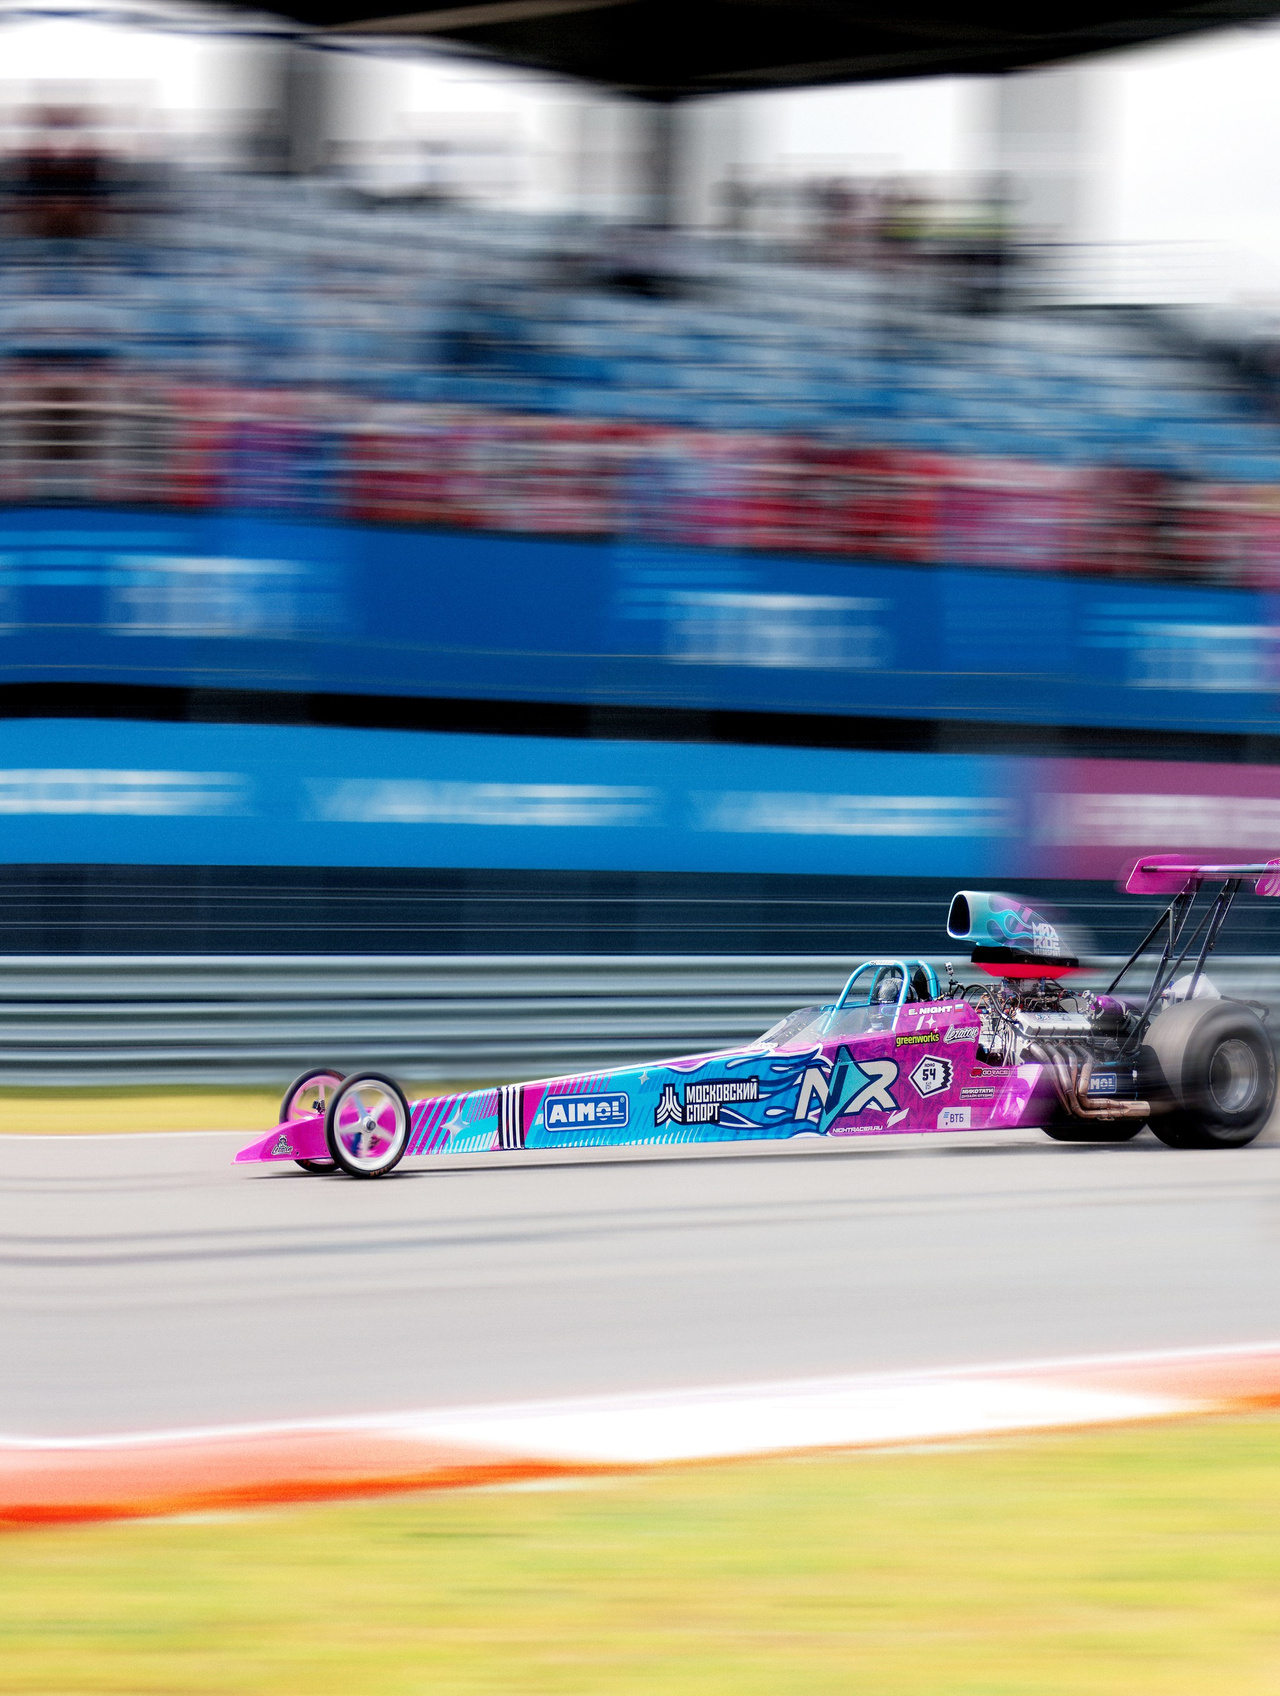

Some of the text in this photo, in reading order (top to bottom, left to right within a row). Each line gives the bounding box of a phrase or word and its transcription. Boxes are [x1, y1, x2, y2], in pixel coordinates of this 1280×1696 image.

[1032, 921, 1058, 937] MAX
[1033, 935, 1060, 950] RIDE
[908, 1005, 953, 1016] E. NIGHT
[896, 1032, 940, 1047] greenworks
[922, 1068, 937, 1081] 54
[686, 1078, 758, 1103] МОСКОВСКИЙ
[1088, 1078, 1115, 1090] MOL
[549, 1100, 625, 1124] AIMOL
[686, 1103, 720, 1122] СПОРТ
[950, 1113, 964, 1123] ВТБ
[832, 1125, 884, 1133] NIGHTRACER.RU
